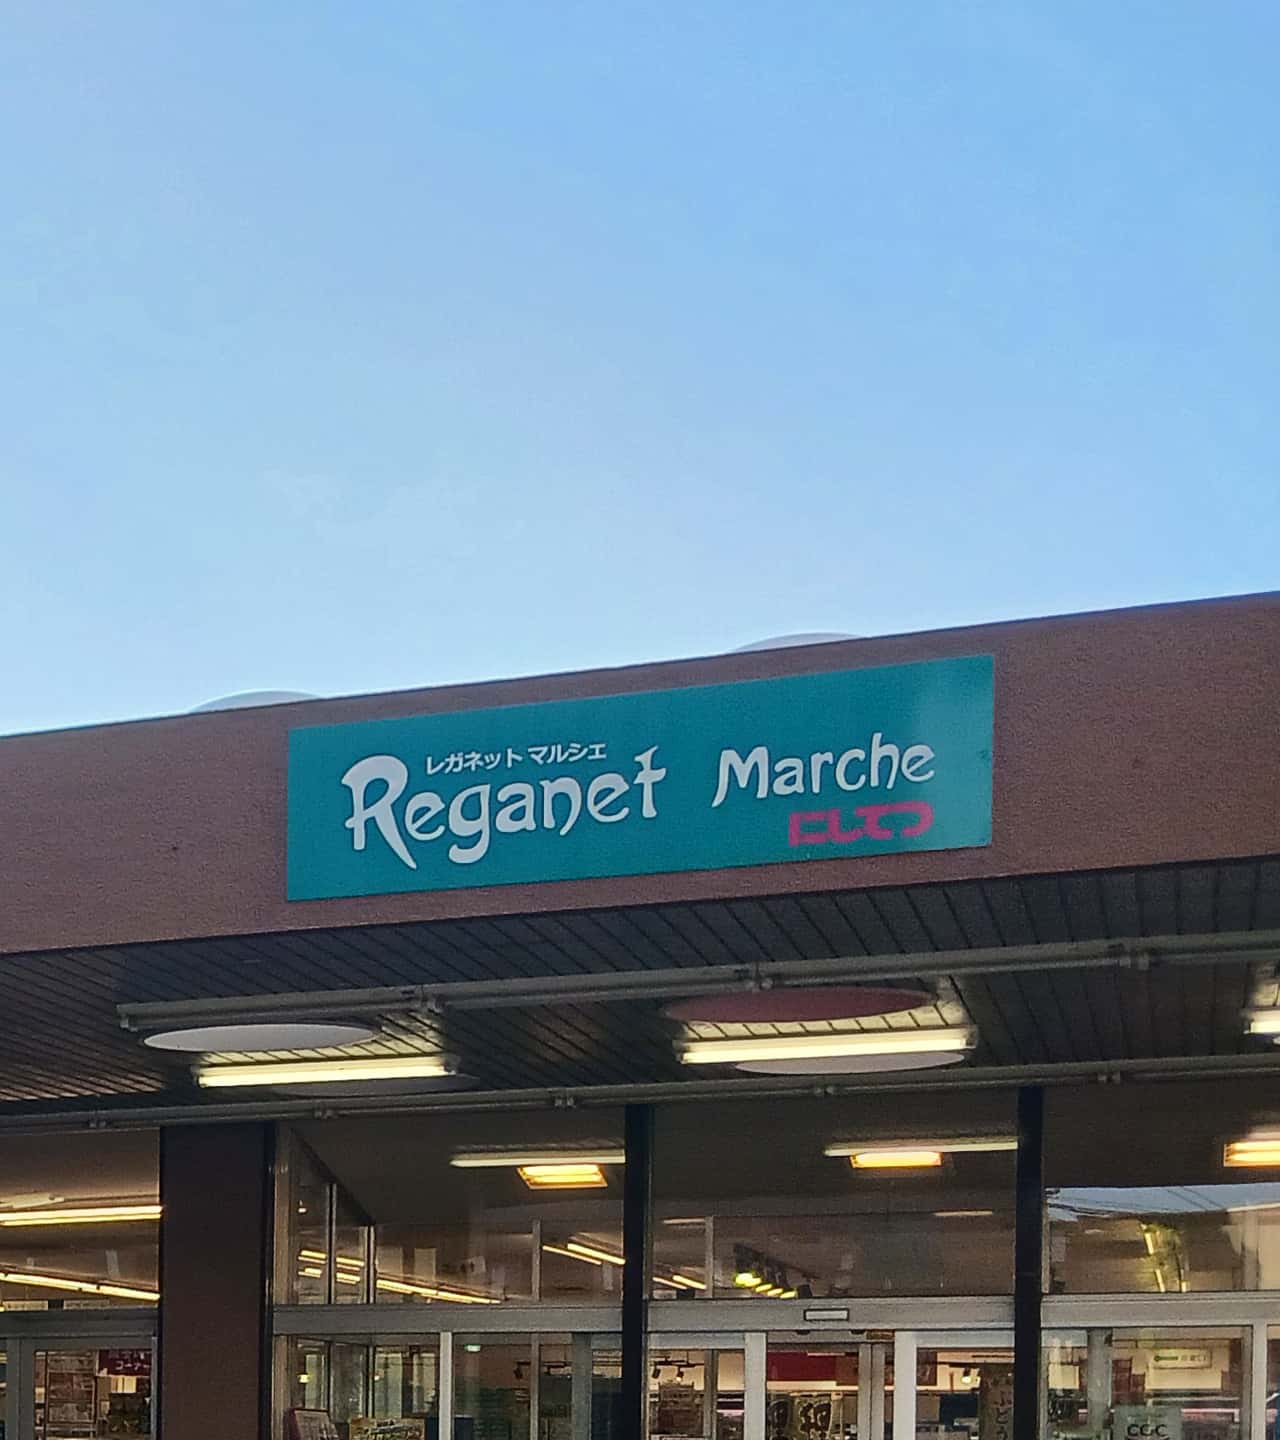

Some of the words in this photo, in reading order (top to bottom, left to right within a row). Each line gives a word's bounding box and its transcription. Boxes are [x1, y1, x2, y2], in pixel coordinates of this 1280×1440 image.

[425, 747, 523, 776] レガネット
[527, 742, 608, 766] マルシェ
[341, 745, 667, 870] Reganet
[711, 732, 936, 808] Marche
[788, 800, 935, 848] にしてつ
[1126, 1423, 1169, 1438] CGC
